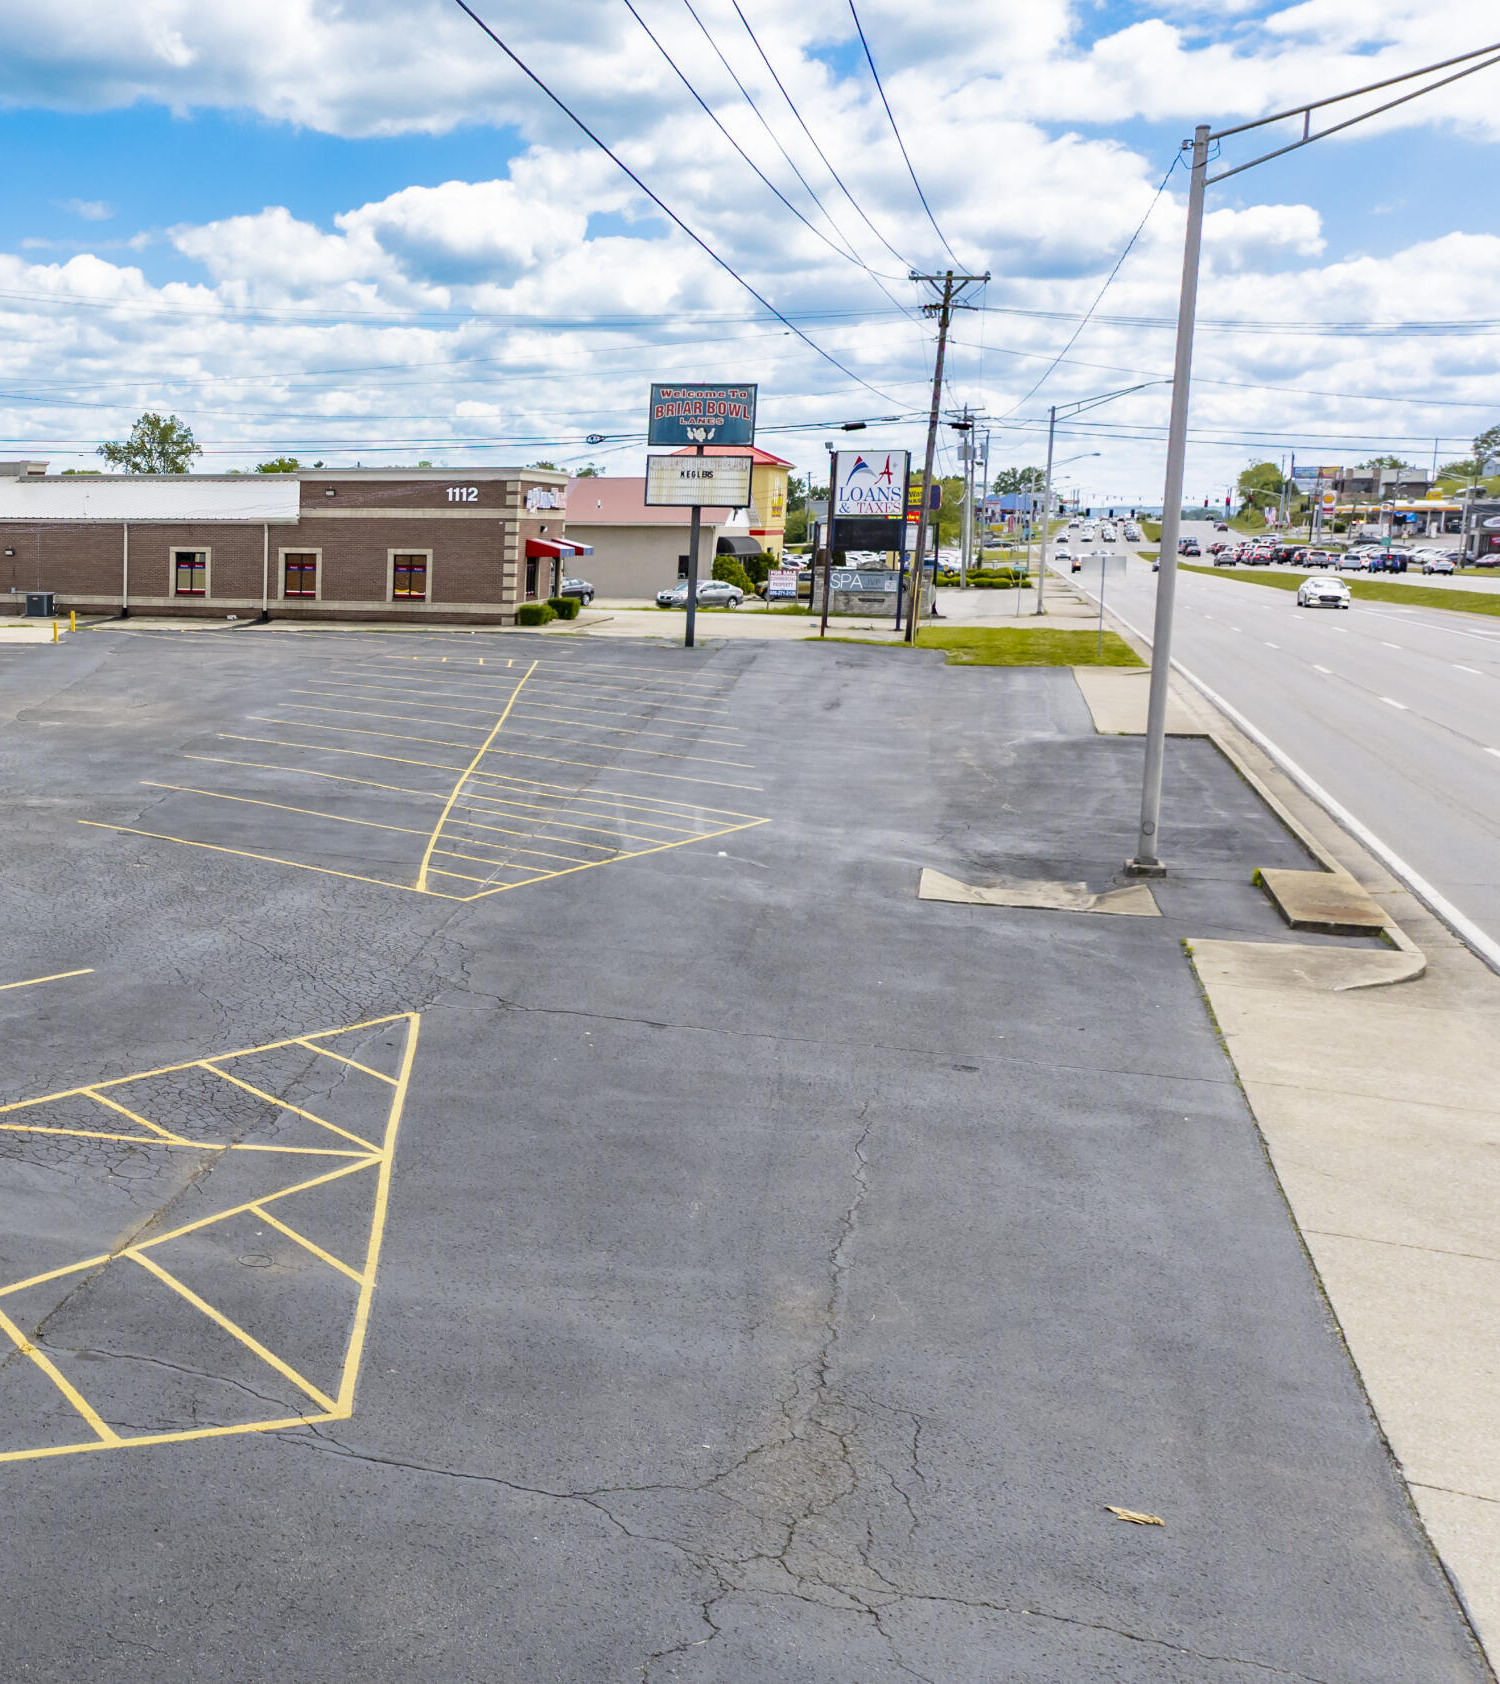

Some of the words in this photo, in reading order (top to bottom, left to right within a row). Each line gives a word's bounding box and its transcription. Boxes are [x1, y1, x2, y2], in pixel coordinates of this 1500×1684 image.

[660, 389, 726, 398] Welcome
[728, 389, 747, 398] To
[655, 400, 703, 419] BRIAR
[706, 400, 750, 420] BOWL
[679, 417, 724, 425] LANES
[446, 487, 479, 502] 1112
[838, 486, 902, 502] LOANS
[838, 502, 851, 513] &
[857, 502, 901, 513] TAXES
[829, 573, 863, 589] SPA
